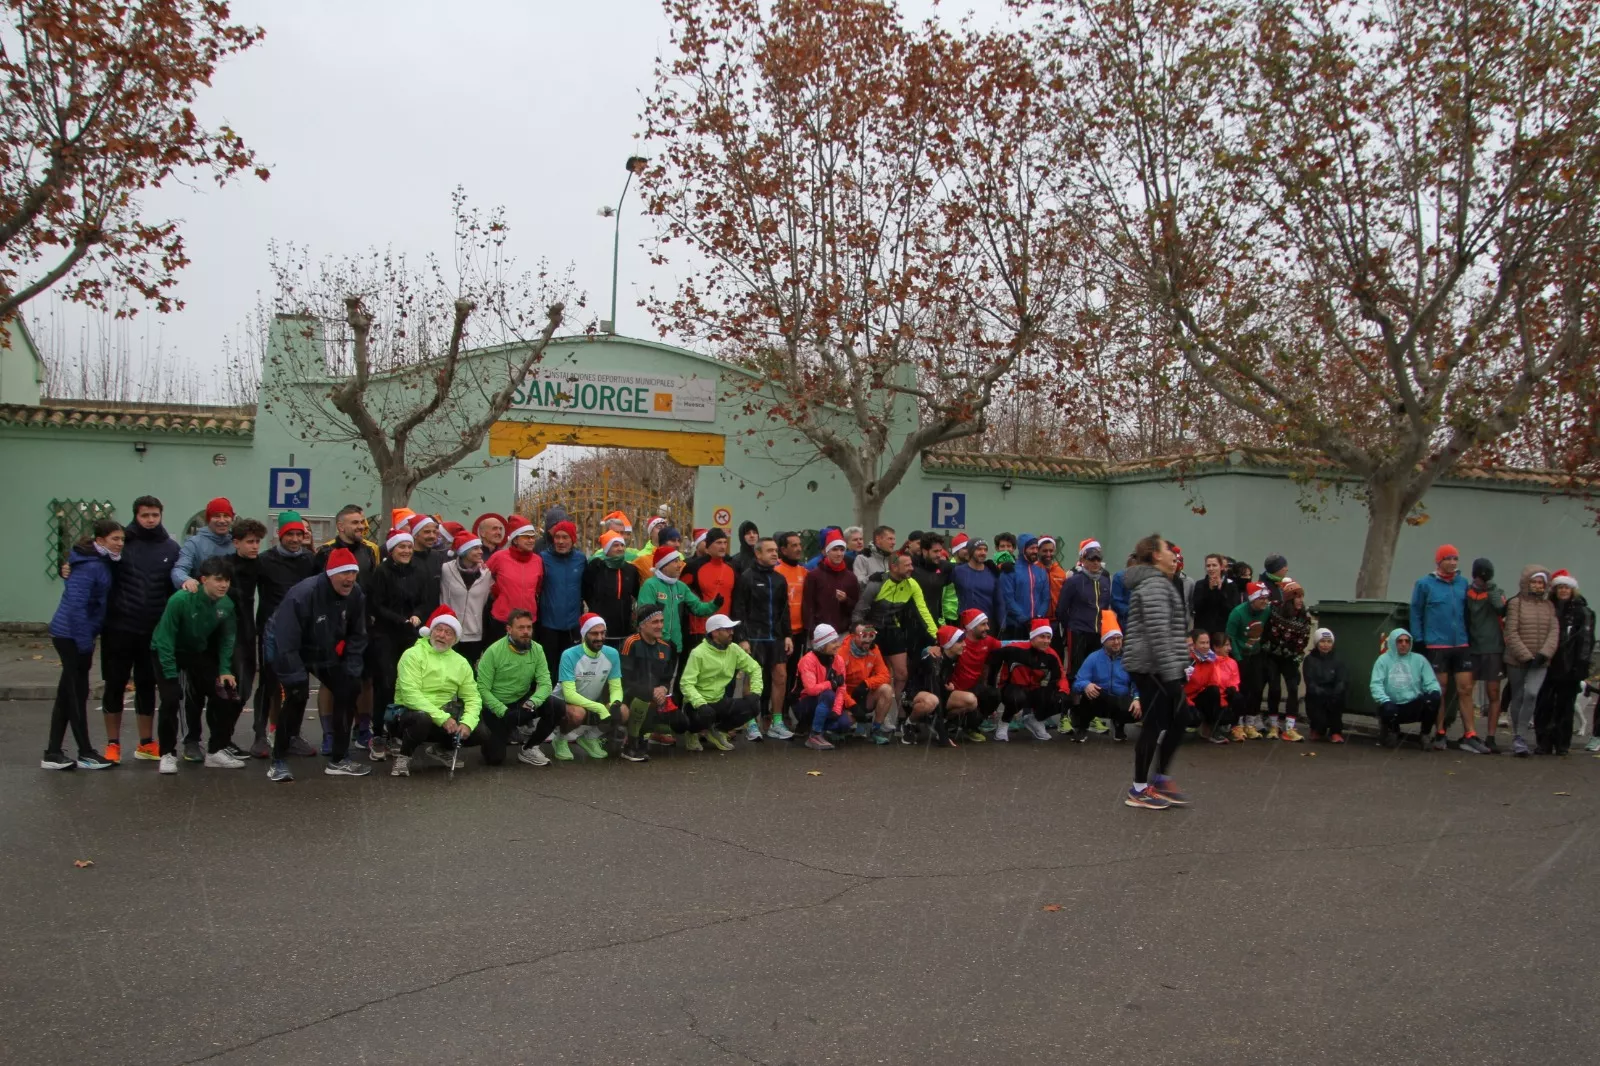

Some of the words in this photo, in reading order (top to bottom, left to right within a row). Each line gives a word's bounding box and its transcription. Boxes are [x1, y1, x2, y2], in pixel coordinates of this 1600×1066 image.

[511, 379, 562, 408] SAN
[568, 383, 650, 414] JORGE
[597, 374, 634, 385] DEPORTIVAS
[635, 377, 675, 388] MUNICIPALES
[276, 472, 303, 505] P
[937, 496, 960, 526] P
